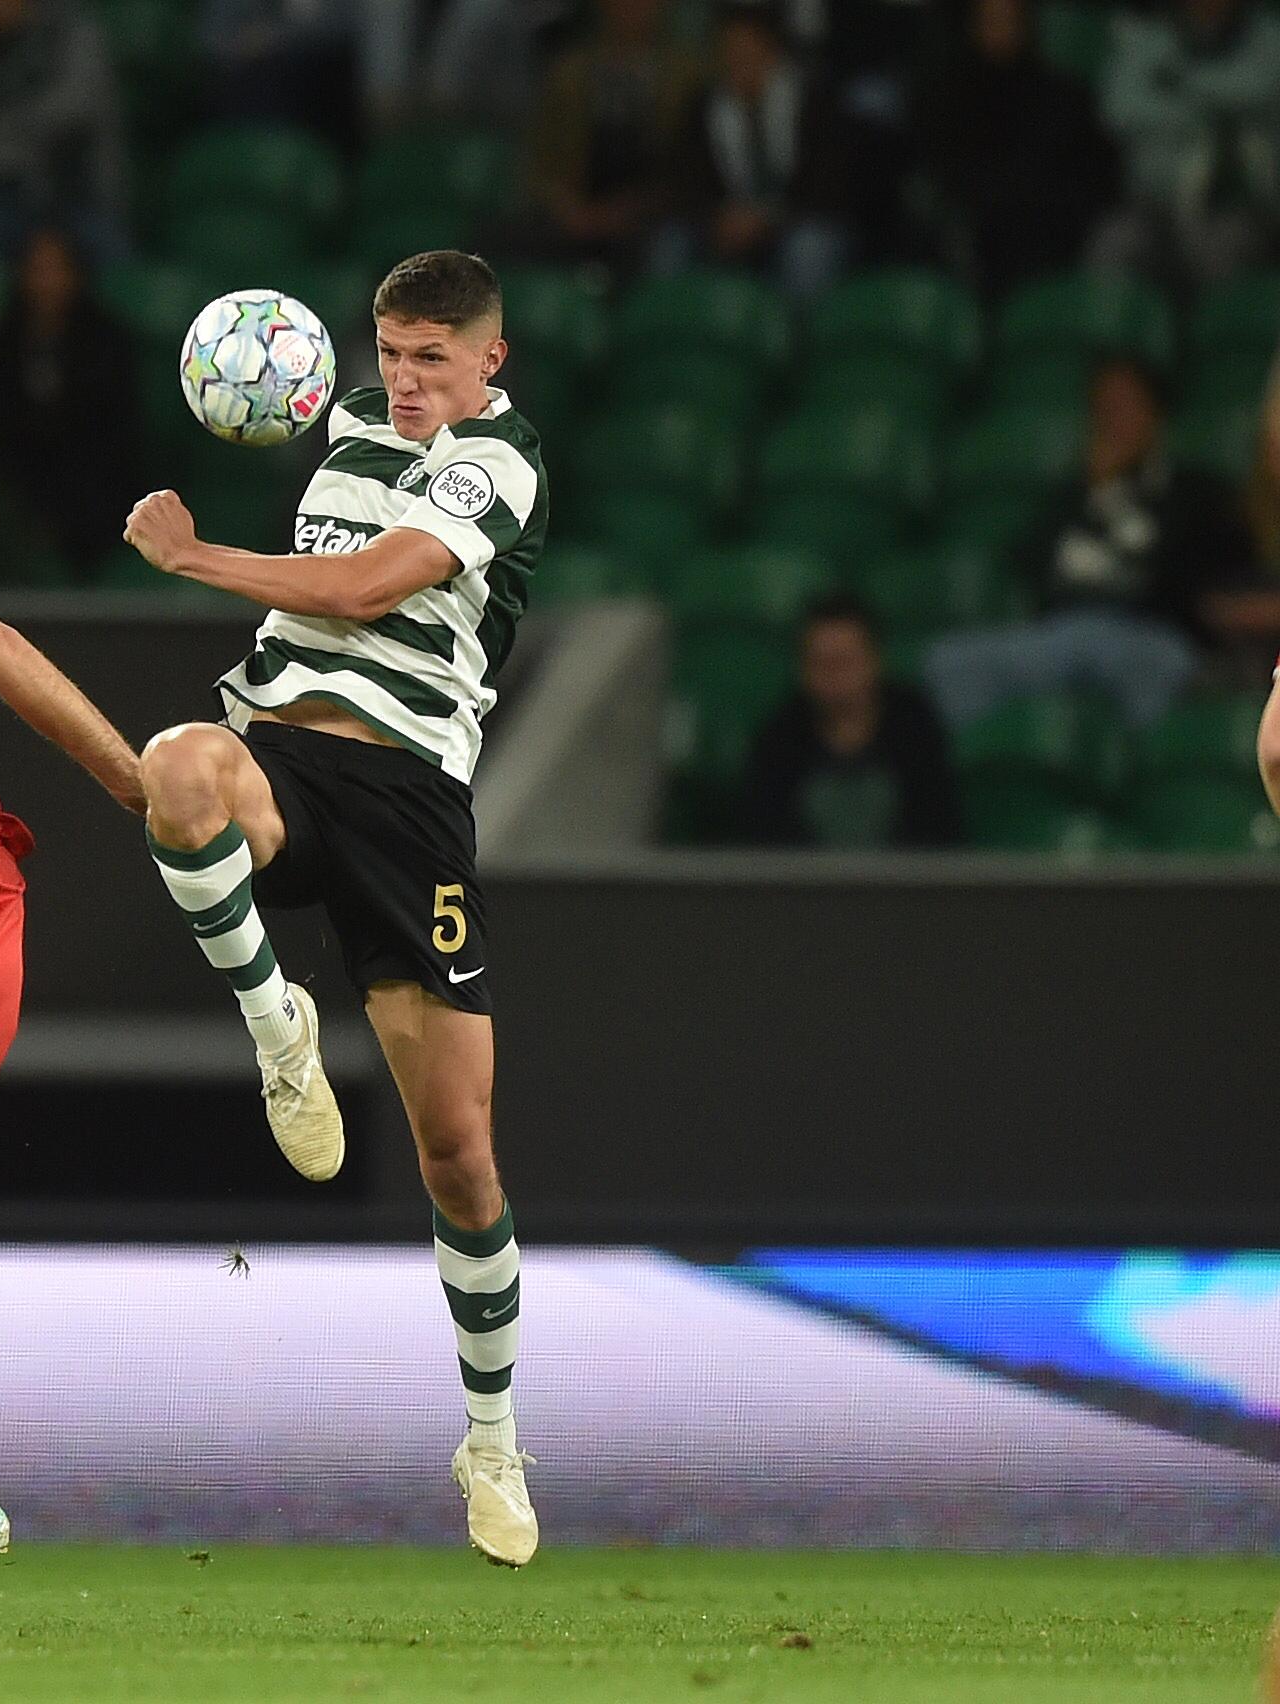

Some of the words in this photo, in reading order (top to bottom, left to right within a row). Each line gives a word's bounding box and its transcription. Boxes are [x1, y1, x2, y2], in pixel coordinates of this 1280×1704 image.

[438, 481, 476, 510] BOCK
[444, 470, 486, 503] SUPER
[432, 883, 467, 953] 5
